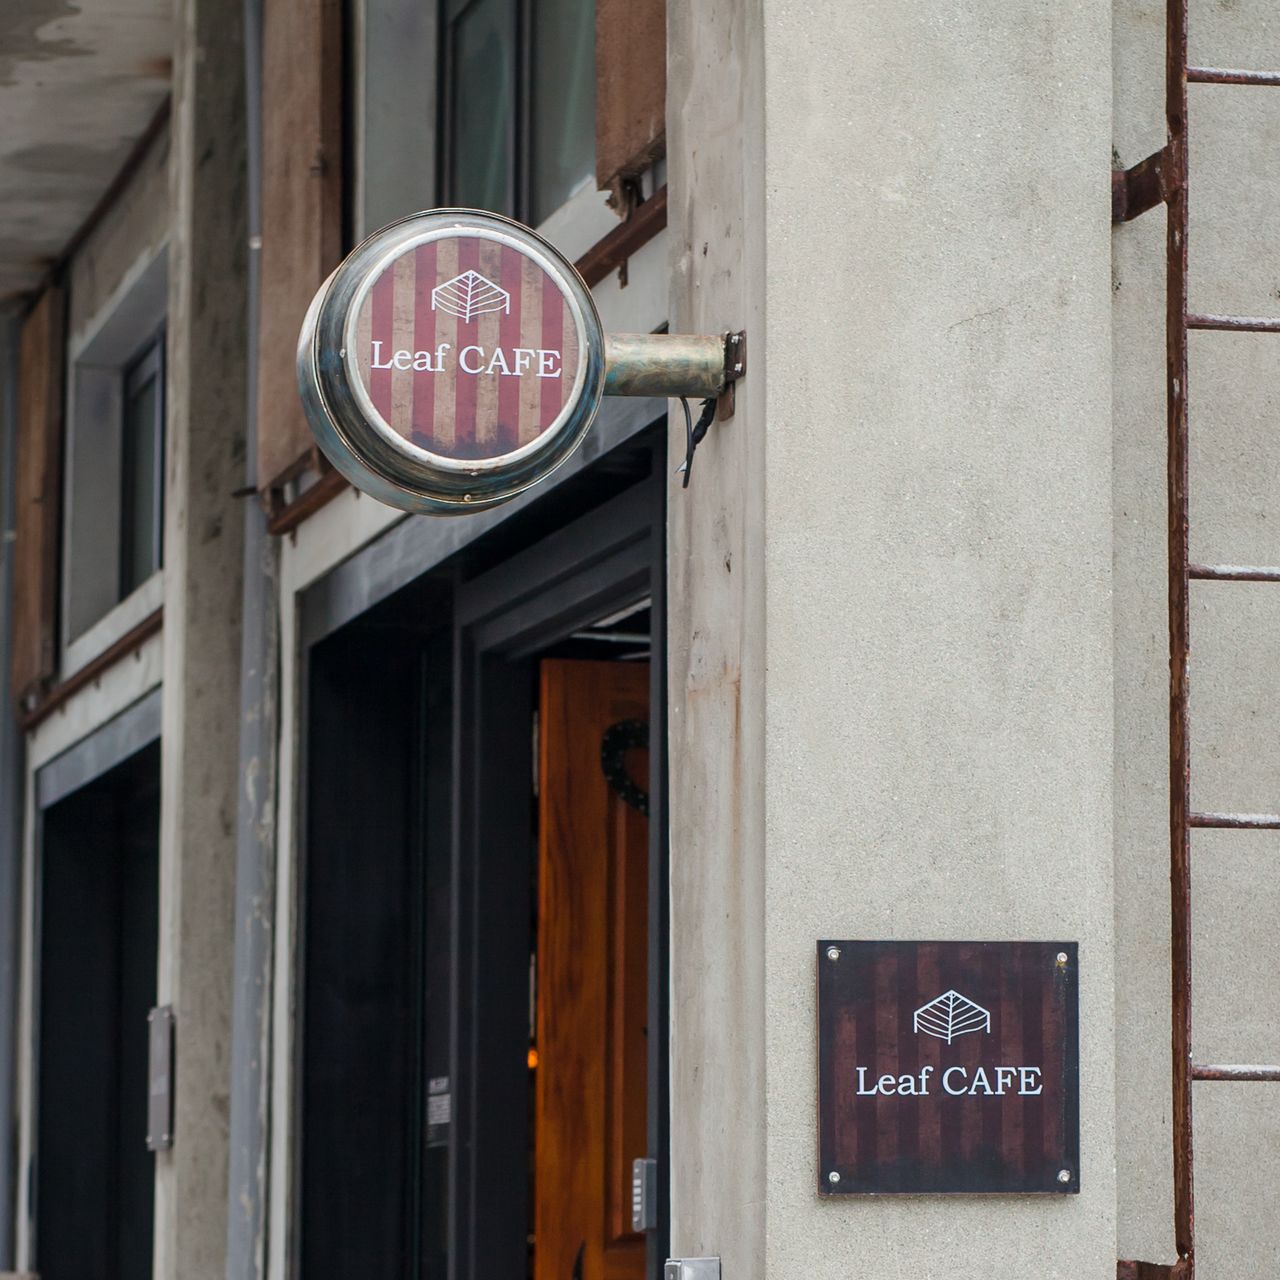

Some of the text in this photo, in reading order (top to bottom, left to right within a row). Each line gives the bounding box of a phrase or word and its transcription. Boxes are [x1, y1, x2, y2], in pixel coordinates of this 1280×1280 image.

[370, 340, 562, 378] Leaf CAFE
[855, 1065, 1044, 1096] Leaf CAFE
